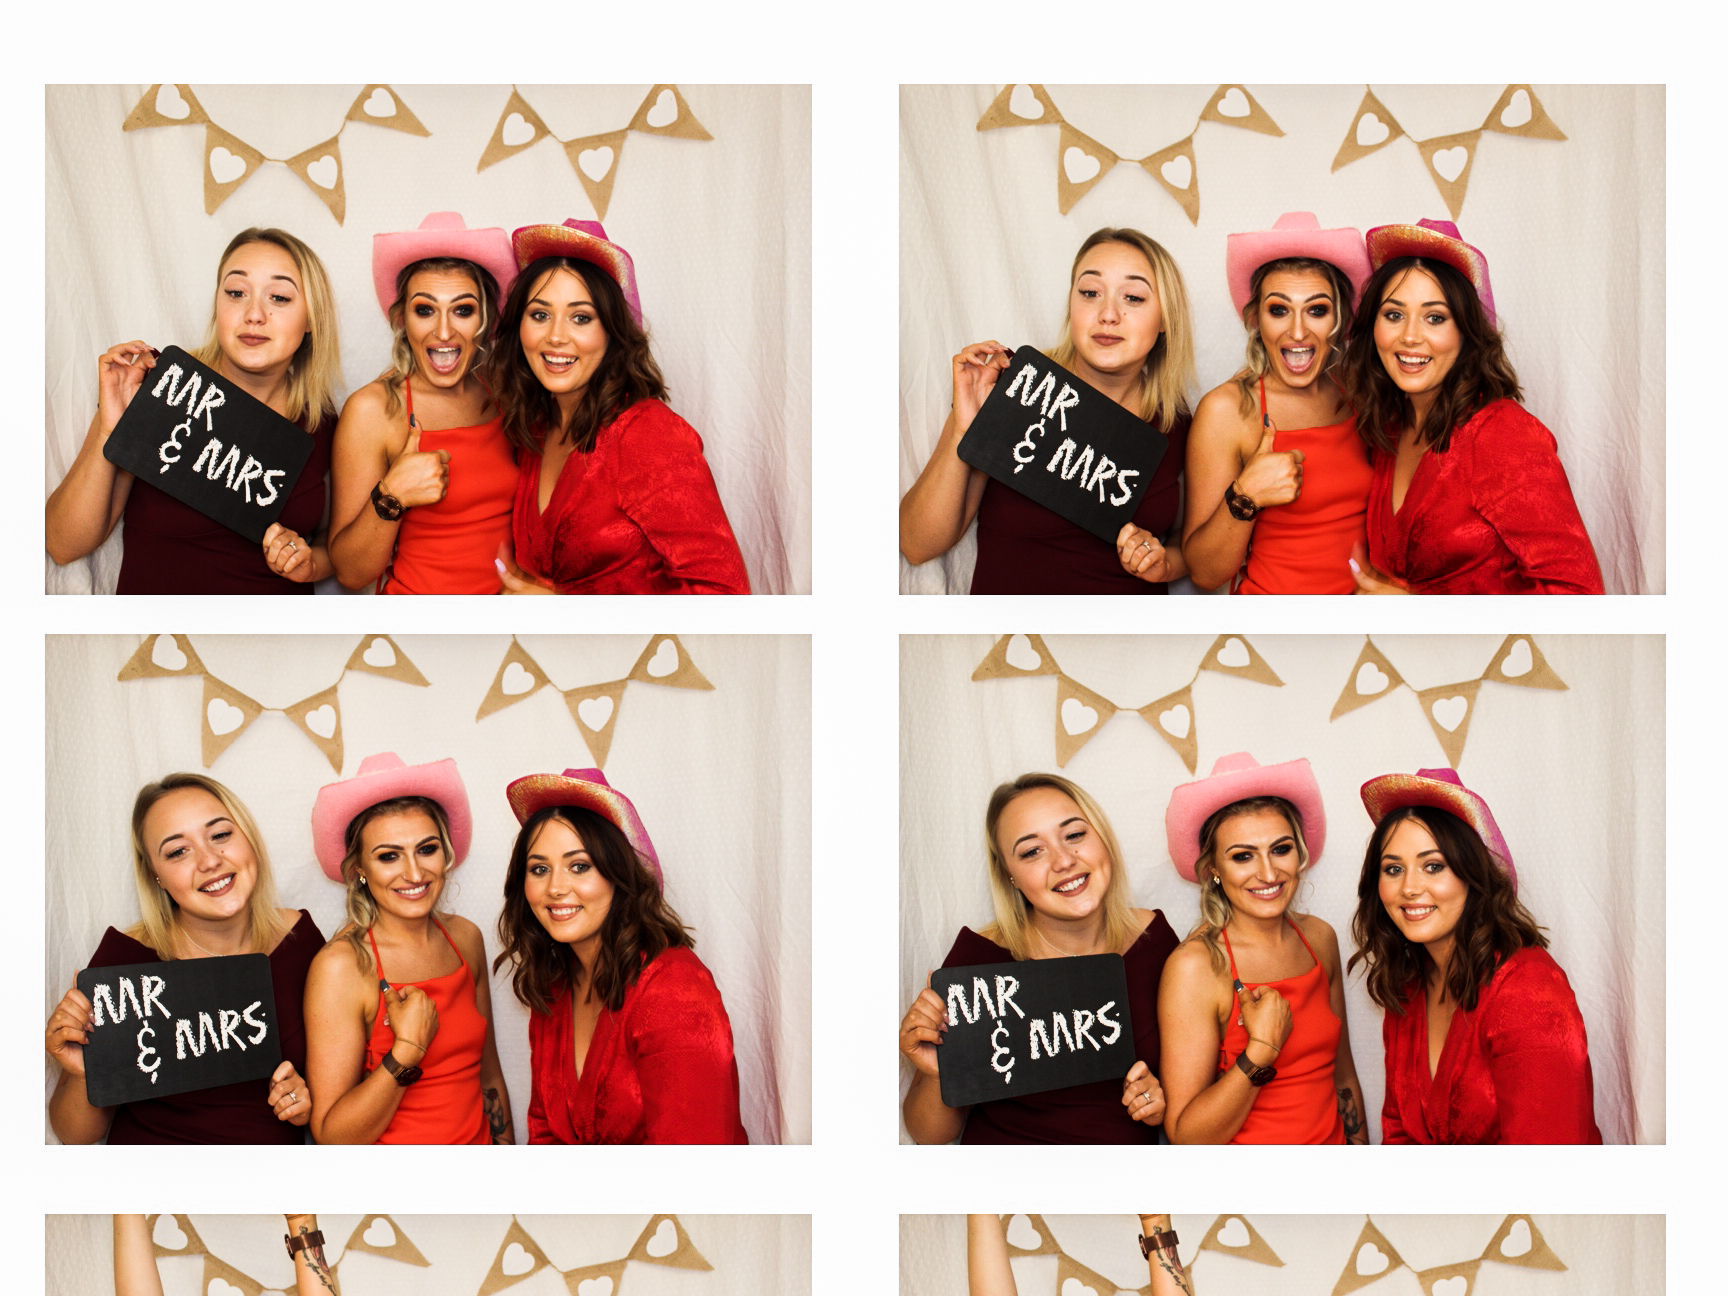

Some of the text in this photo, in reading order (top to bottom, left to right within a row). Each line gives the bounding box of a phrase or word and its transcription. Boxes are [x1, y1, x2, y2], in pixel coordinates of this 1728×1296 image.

[152, 362, 226, 431] MR
[1006, 362, 1080, 431] MR
[159, 418, 192, 474] &
[1013, 418, 1046, 474] &
[93, 975, 171, 1027] MR
[947, 975, 1025, 1027] MR
[136, 1020, 161, 1084] &
[990, 1020, 1015, 1084] &
